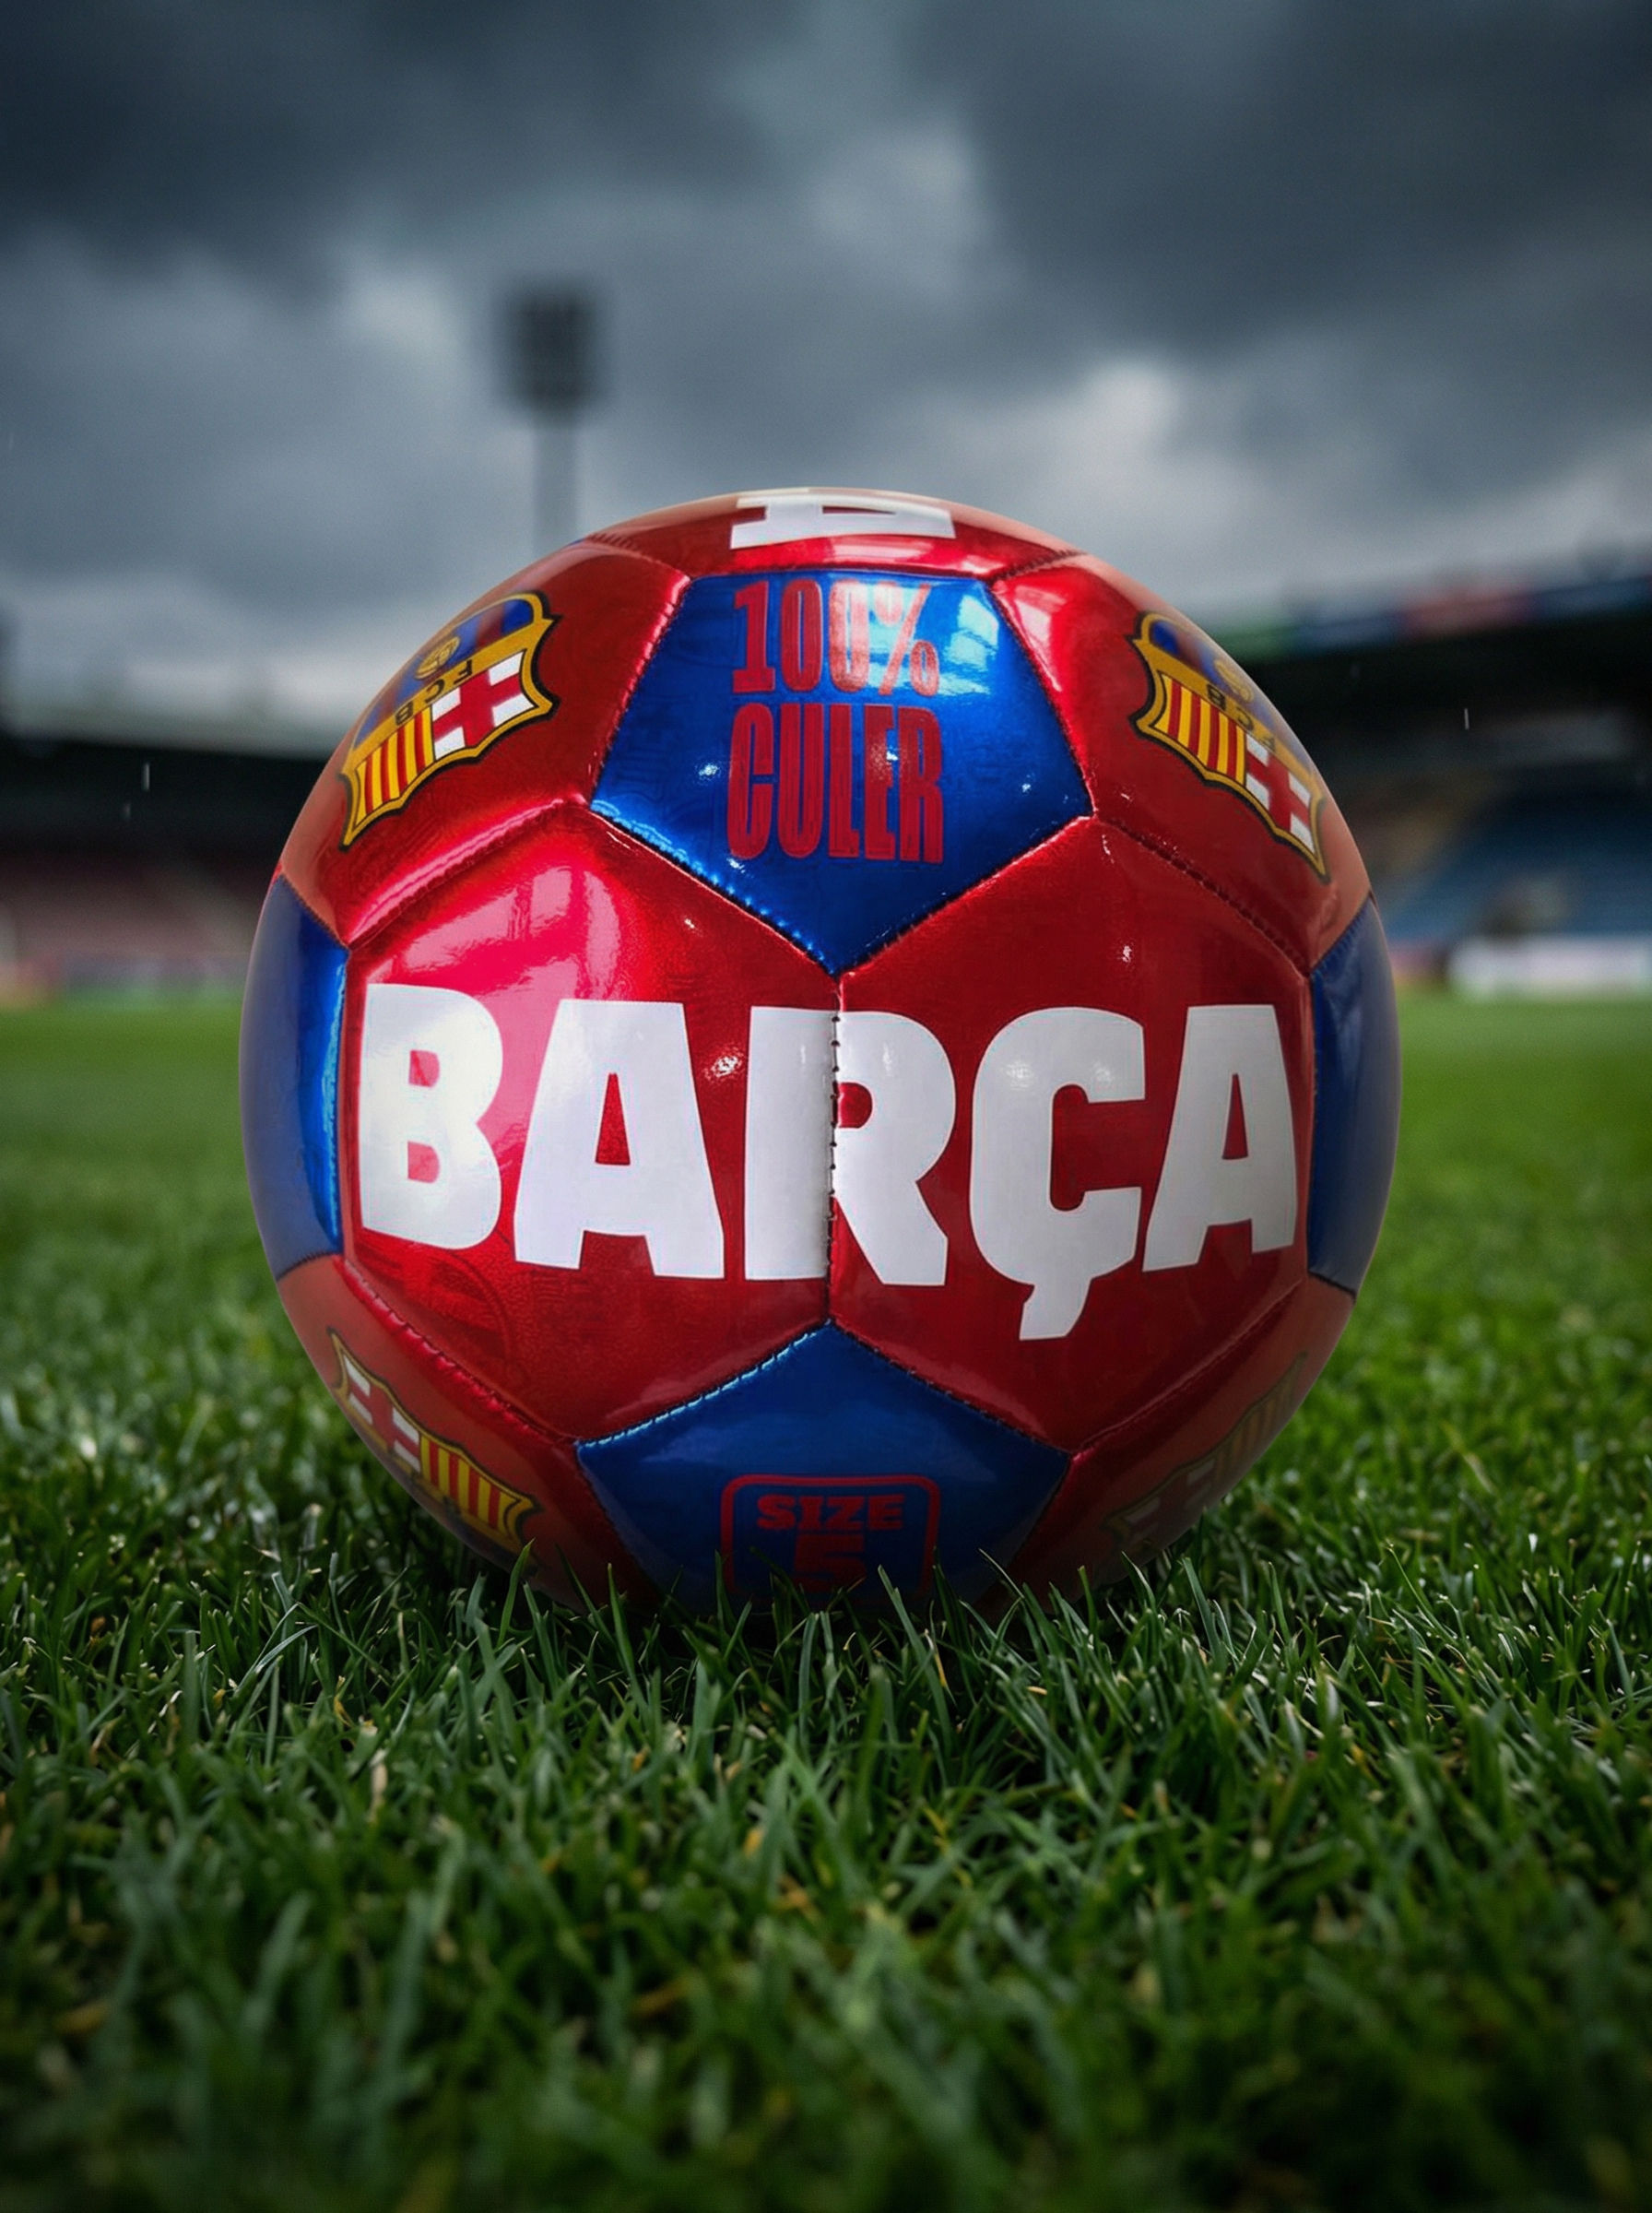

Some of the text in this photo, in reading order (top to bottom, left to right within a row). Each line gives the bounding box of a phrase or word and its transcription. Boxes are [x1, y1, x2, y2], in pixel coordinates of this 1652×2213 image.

[732, 578, 940, 697] 100%
[726, 703, 944, 864] CULER
[359, 983, 1297, 1342] BARÇA
[756, 1493, 906, 1531] SIZE
[793, 1533, 867, 1594] 5
